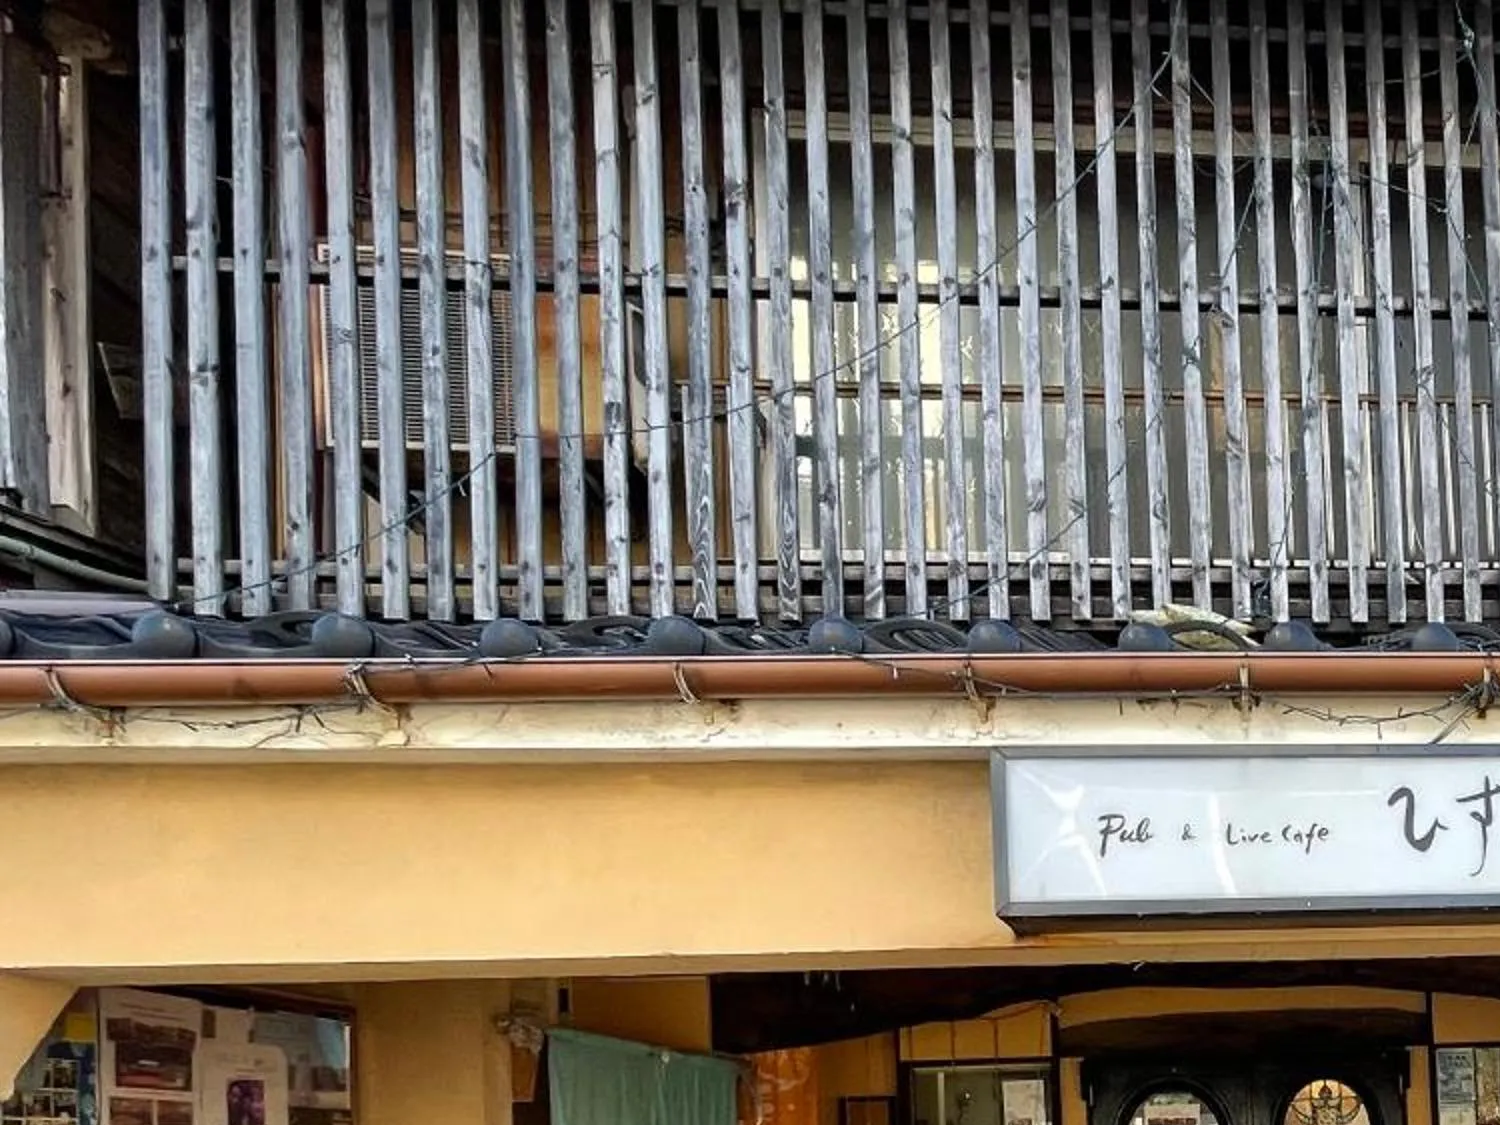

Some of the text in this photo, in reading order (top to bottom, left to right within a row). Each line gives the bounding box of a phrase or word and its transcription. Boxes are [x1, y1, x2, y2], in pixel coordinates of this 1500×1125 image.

[1098, 814, 1153, 857] Pub
[1226, 823, 1272, 845] Live
[1281, 823, 1330, 854] Cafe
